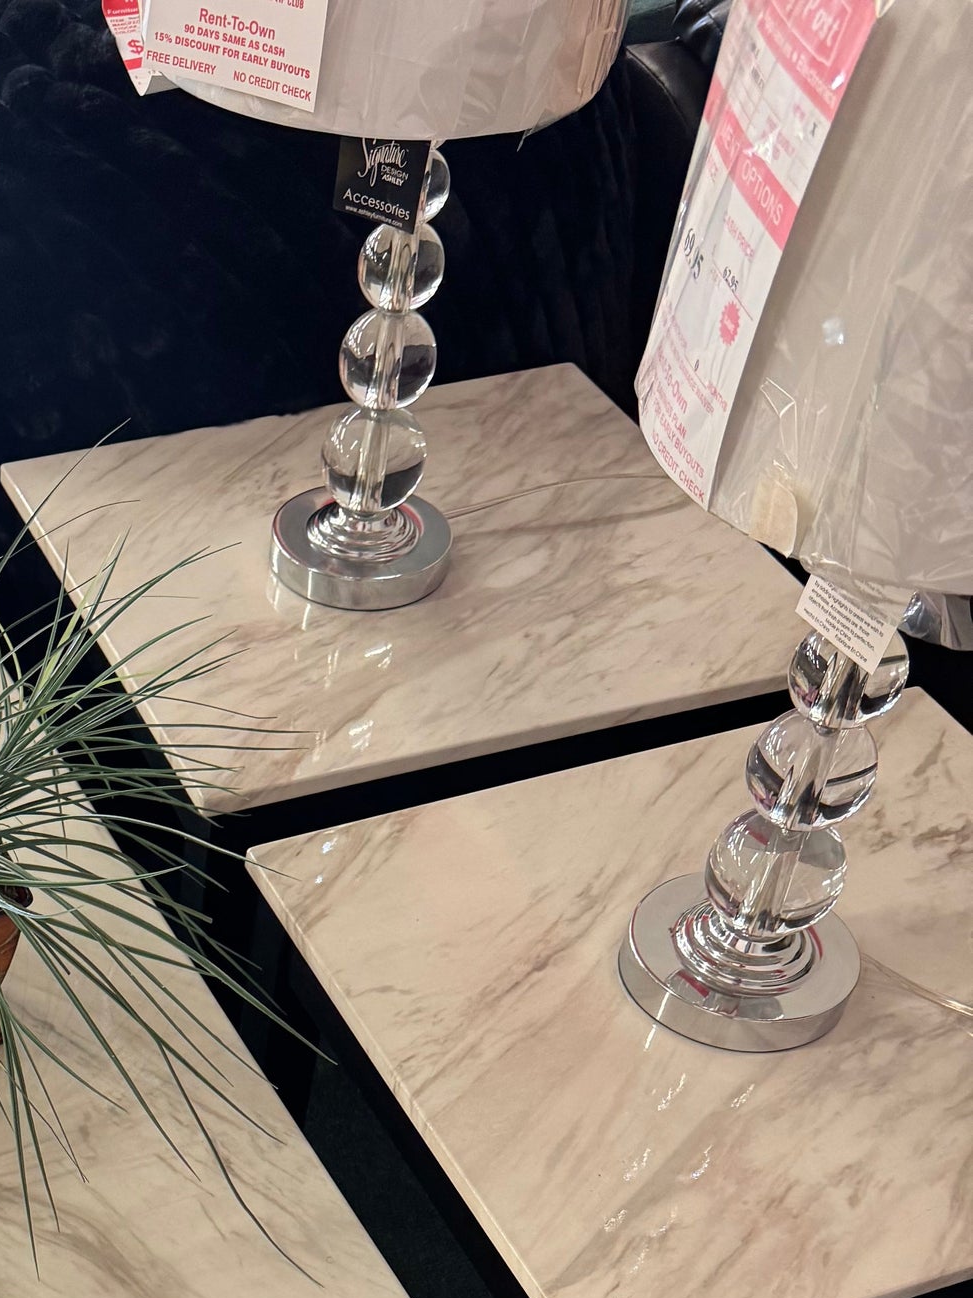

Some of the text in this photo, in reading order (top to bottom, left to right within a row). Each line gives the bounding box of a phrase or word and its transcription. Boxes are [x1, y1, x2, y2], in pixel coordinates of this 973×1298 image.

[199, 8, 276, 40] Rent-To-Own
[154, 32, 311, 80] 15% DISCOUNT FOR EARLY BUYOUTS
[184, 24, 285, 58] 90 DAYS SAME AS CASH
[146, 50, 217, 75] FREE DELIVERY
[233, 70, 311, 102] NO CREDIT CHECK
[381, 165, 409, 180] DESIGN
[382, 174, 403, 186] ASHLEY
[343, 188, 410, 220] Accessories
[742, 160, 784, 226] OPTIONS
[671, 412, 686, 439] PLAN
[660, 412, 704, 478] EARLY BUYOUTS
[658, 441, 704, 502] CREDIT CHECK
